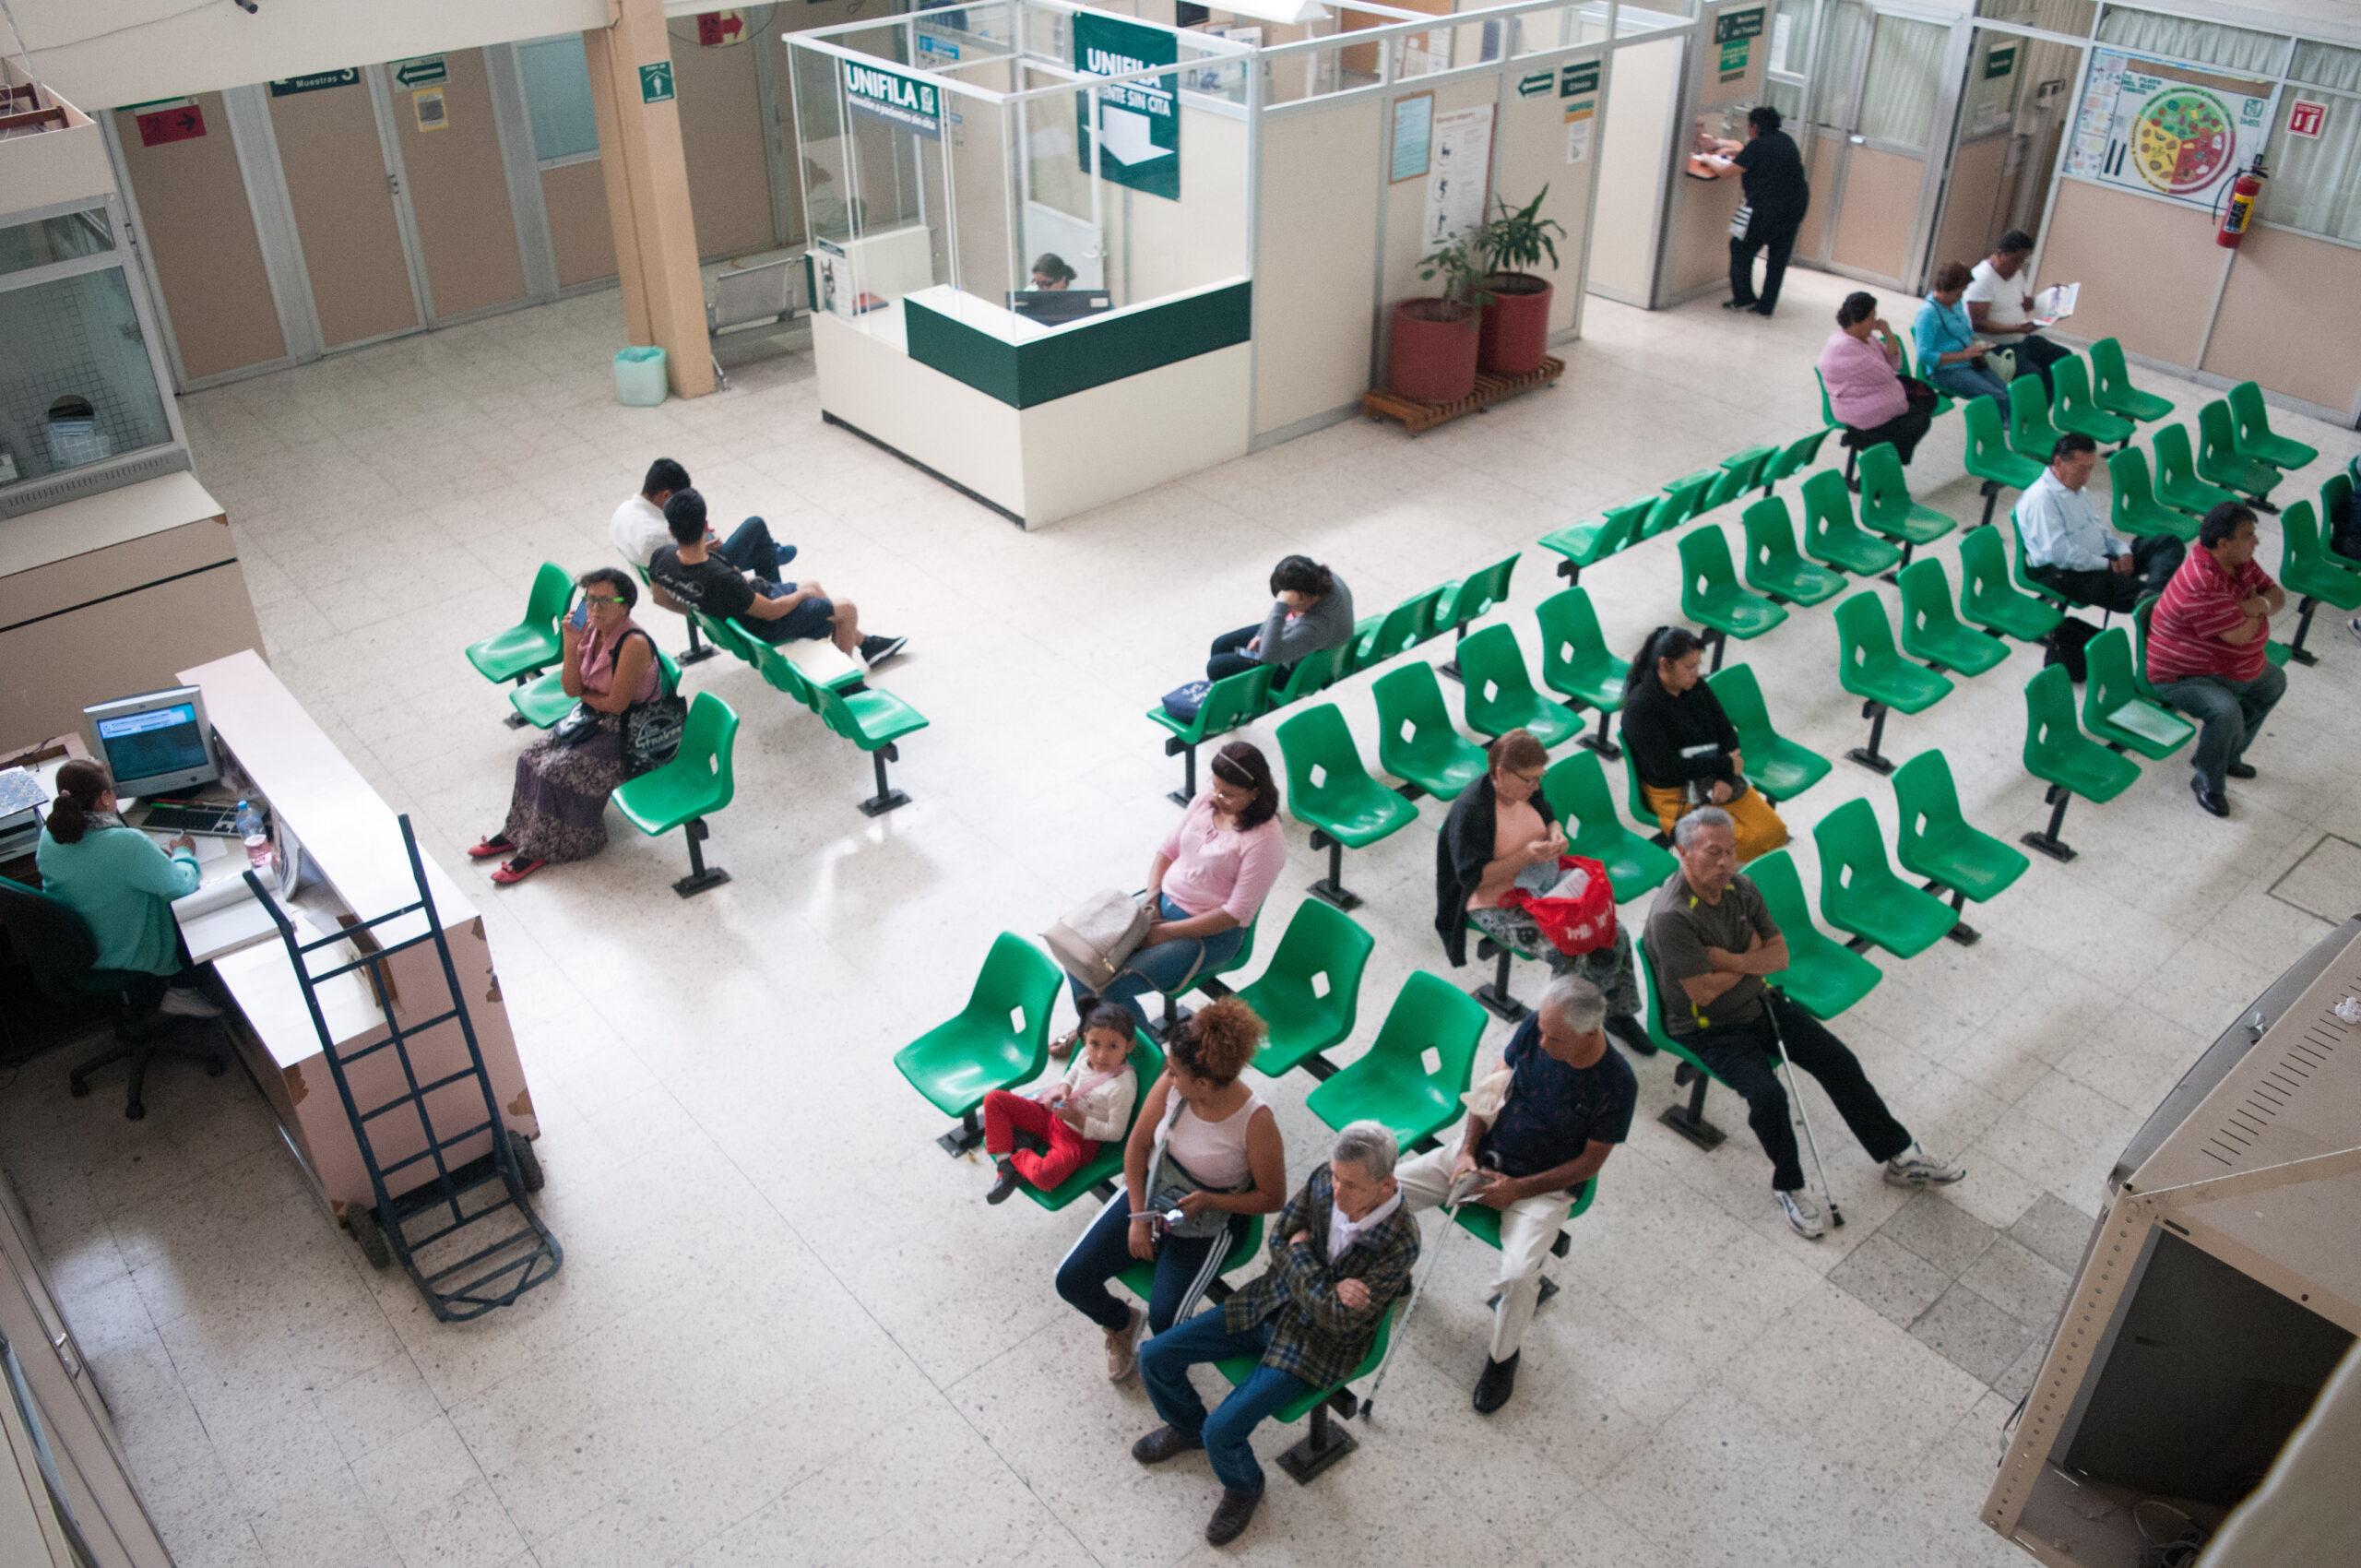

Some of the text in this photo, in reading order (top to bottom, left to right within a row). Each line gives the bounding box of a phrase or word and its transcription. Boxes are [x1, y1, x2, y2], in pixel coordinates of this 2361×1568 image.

[296, 76, 338, 89] Muestras
[845, 64, 919, 110] UNIFILA
[1127, 90, 1145, 110] SIN
[1147, 96, 1171, 116] CITA
